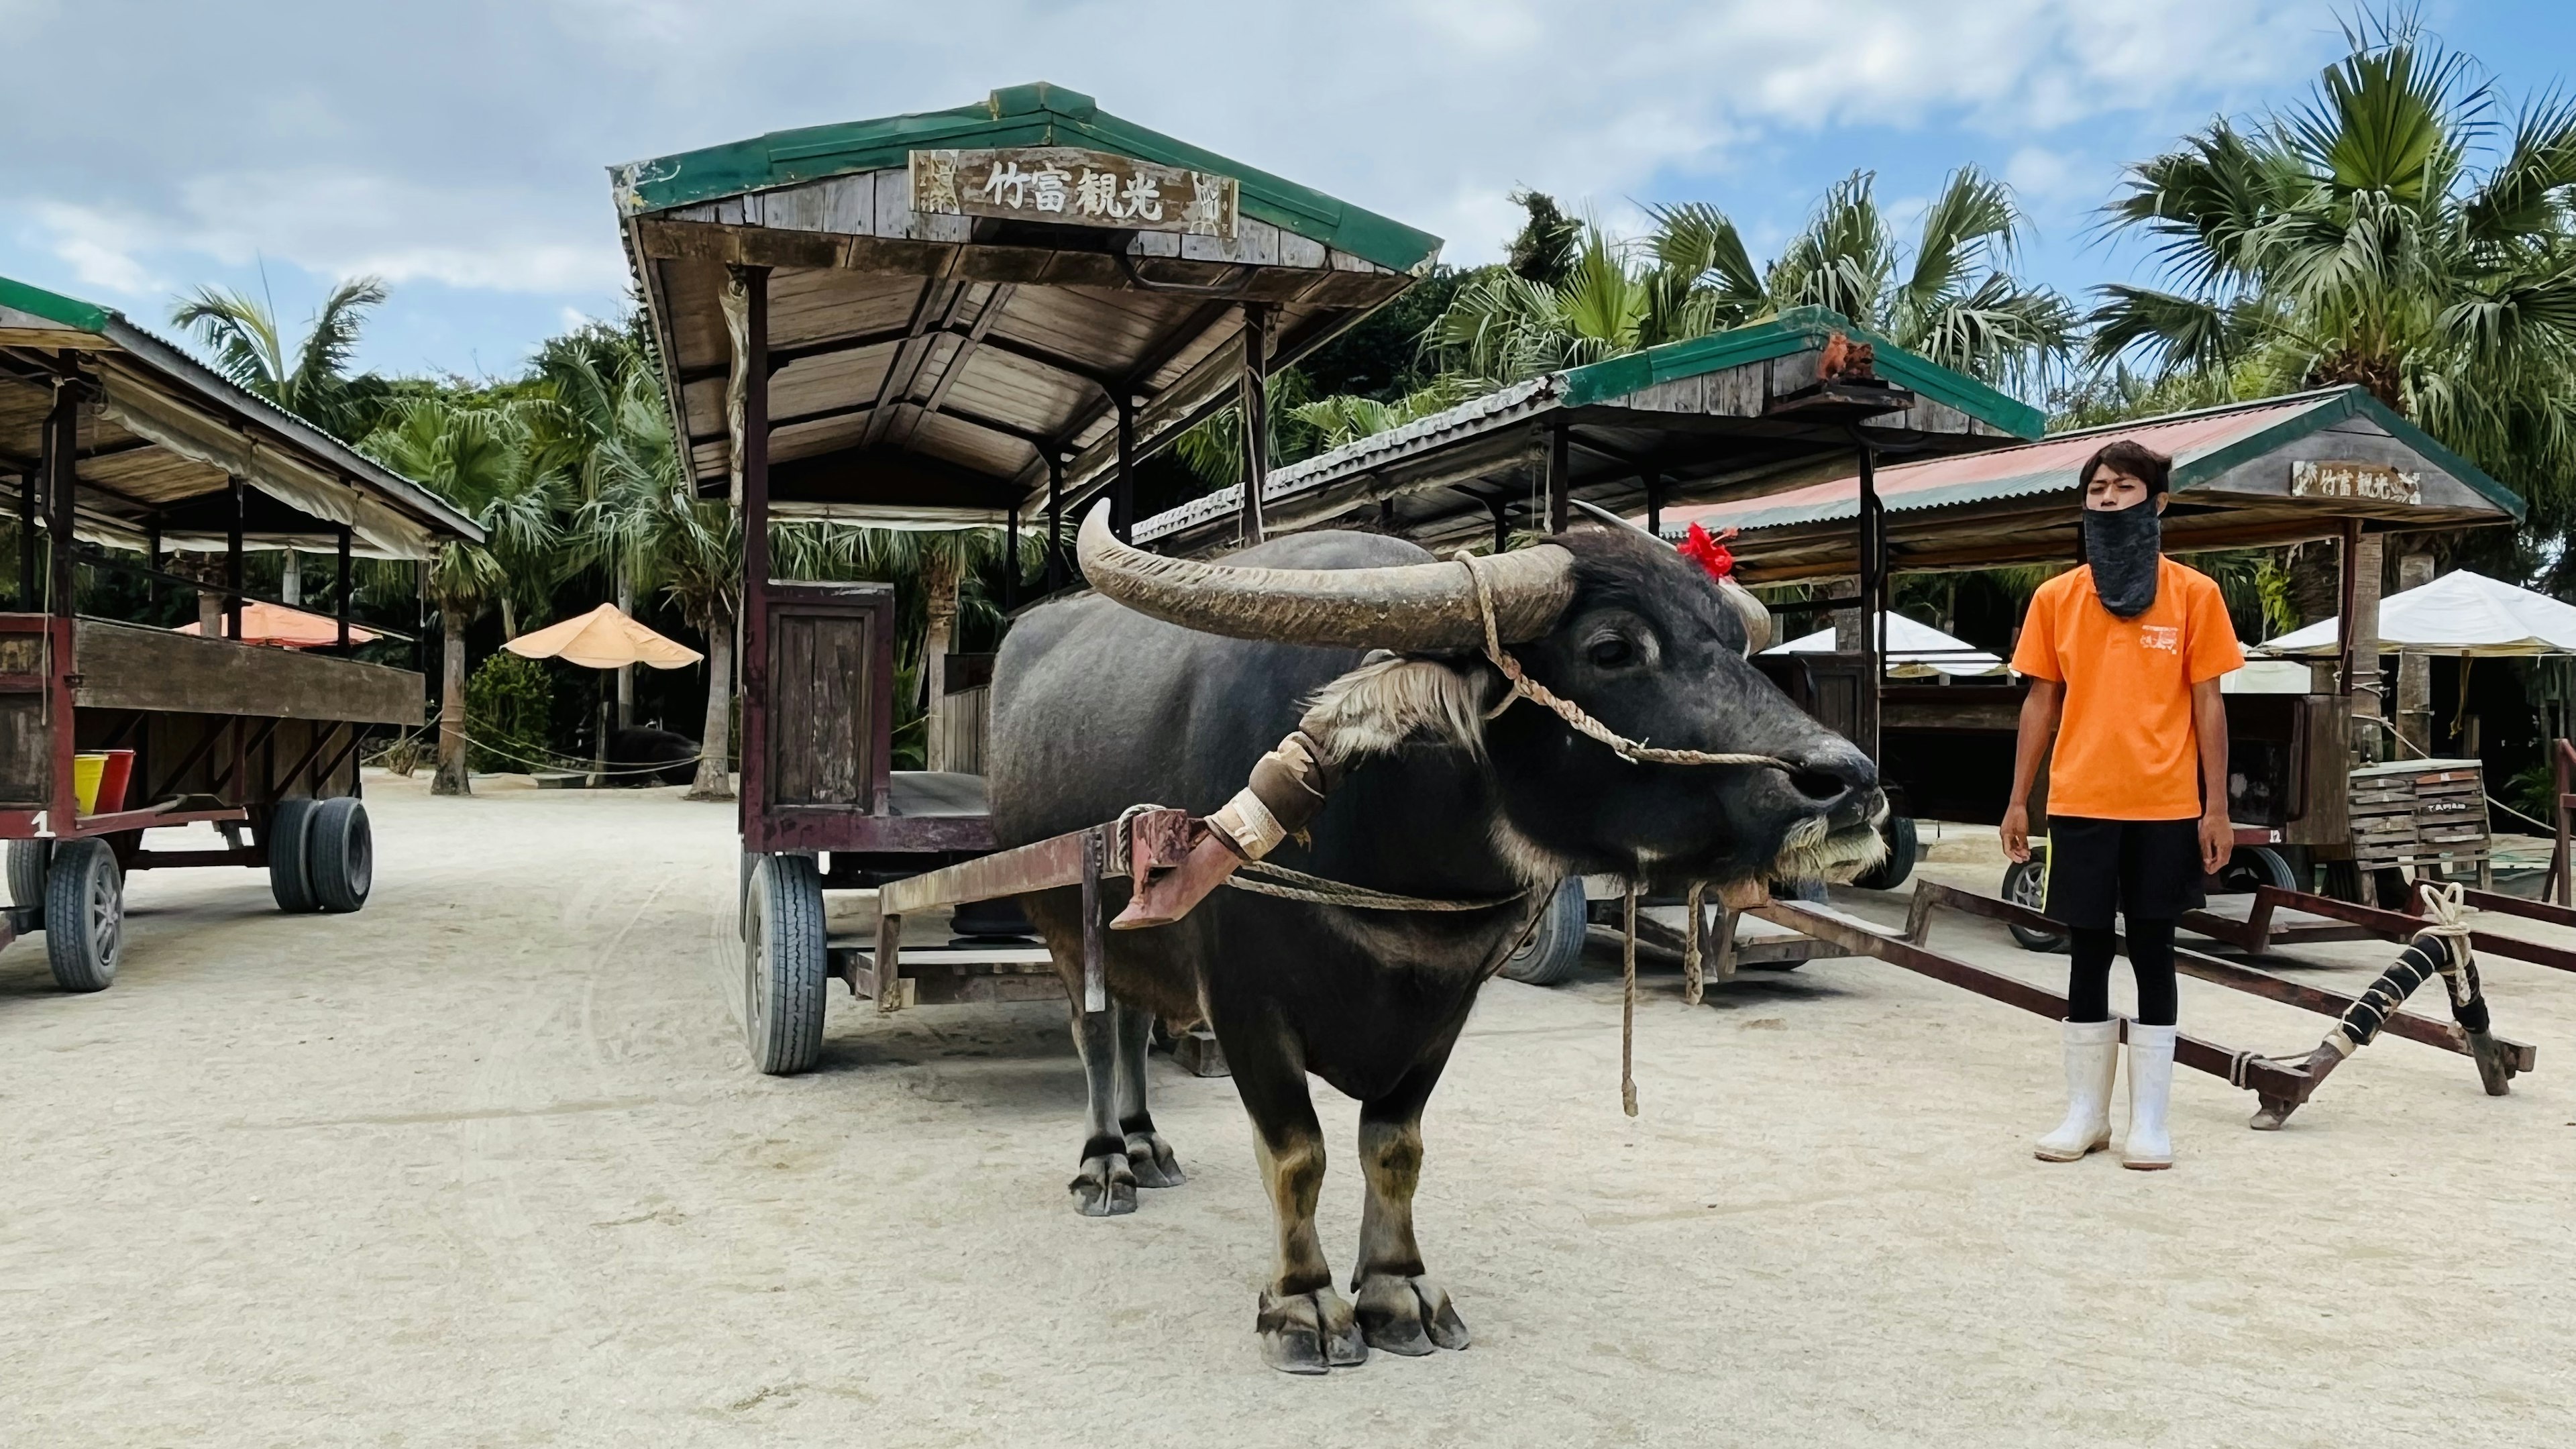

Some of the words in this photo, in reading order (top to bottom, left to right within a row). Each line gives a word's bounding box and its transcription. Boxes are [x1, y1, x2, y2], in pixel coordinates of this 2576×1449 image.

[984, 160, 1163, 221] 竹富観光
[31, 810, 56, 838] 1
